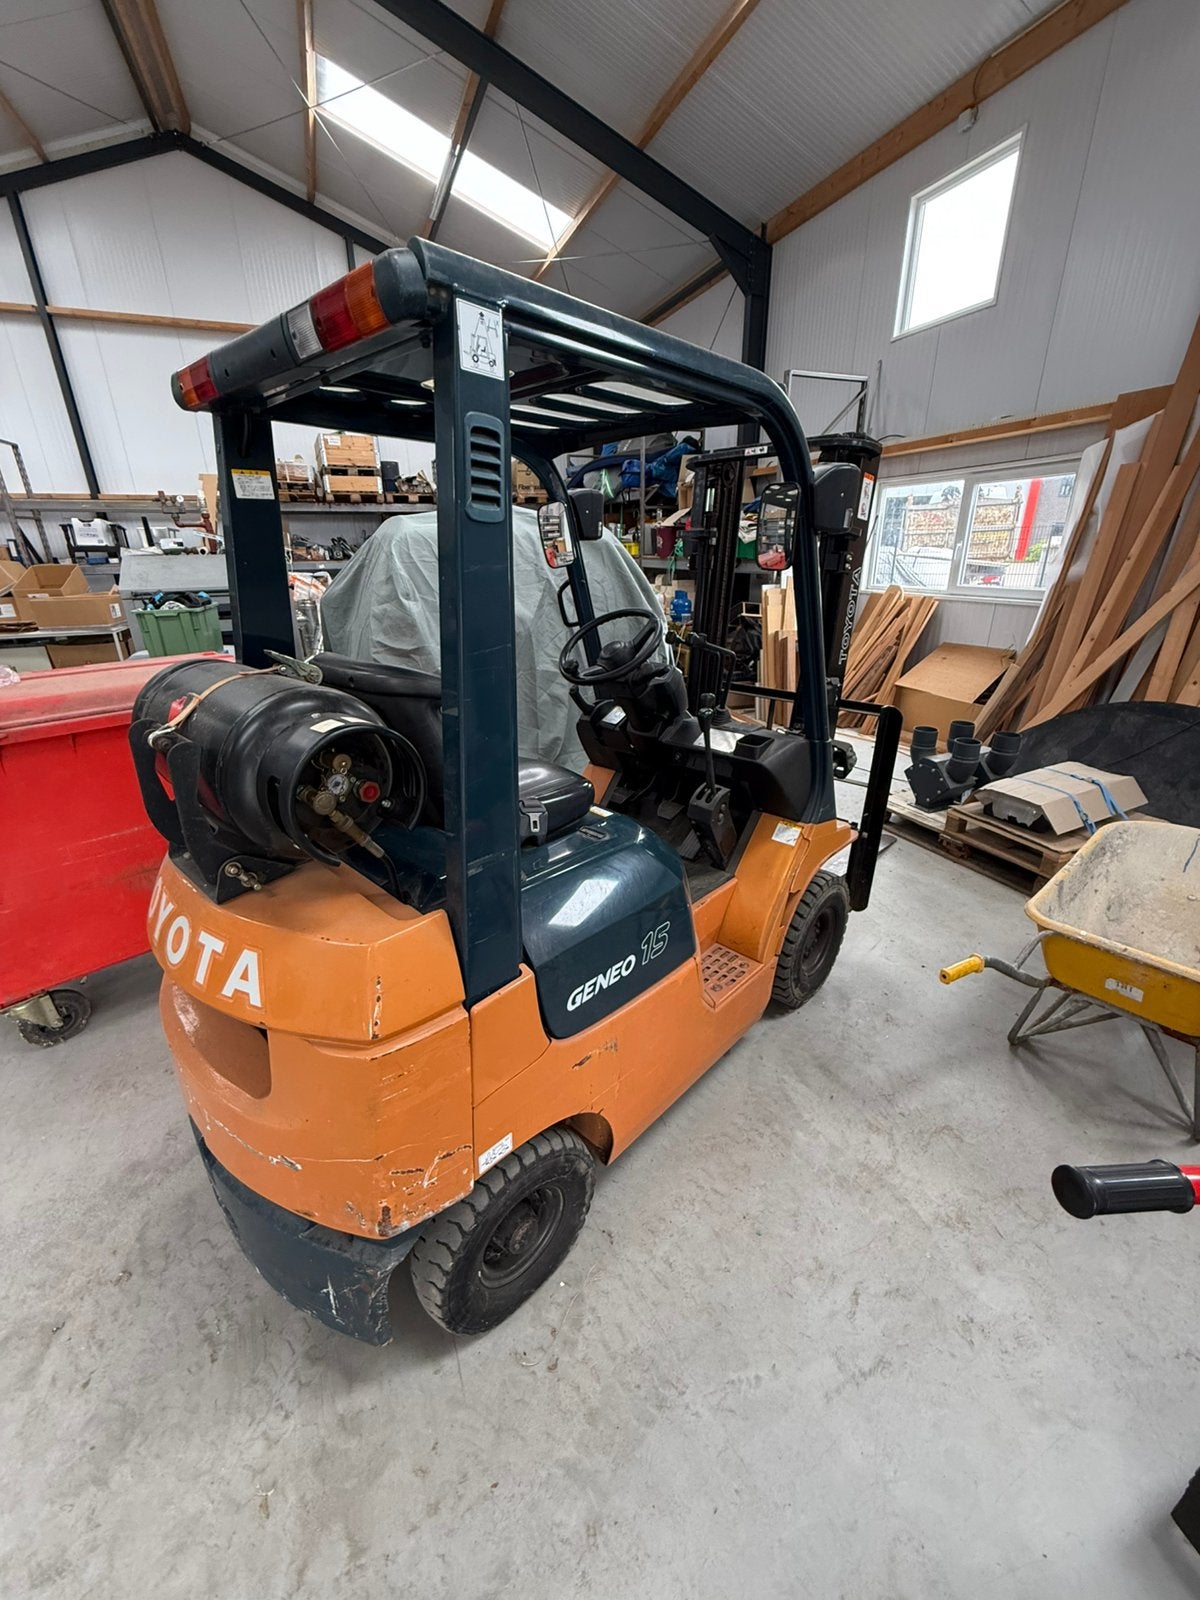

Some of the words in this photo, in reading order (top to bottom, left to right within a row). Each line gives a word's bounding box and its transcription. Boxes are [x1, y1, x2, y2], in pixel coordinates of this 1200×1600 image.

[838, 566, 862, 665] TOYOTA
[147, 876, 262, 1008] OYOTA
[566, 954, 637, 1012] GENEO
[641, 920, 671, 966] 15
